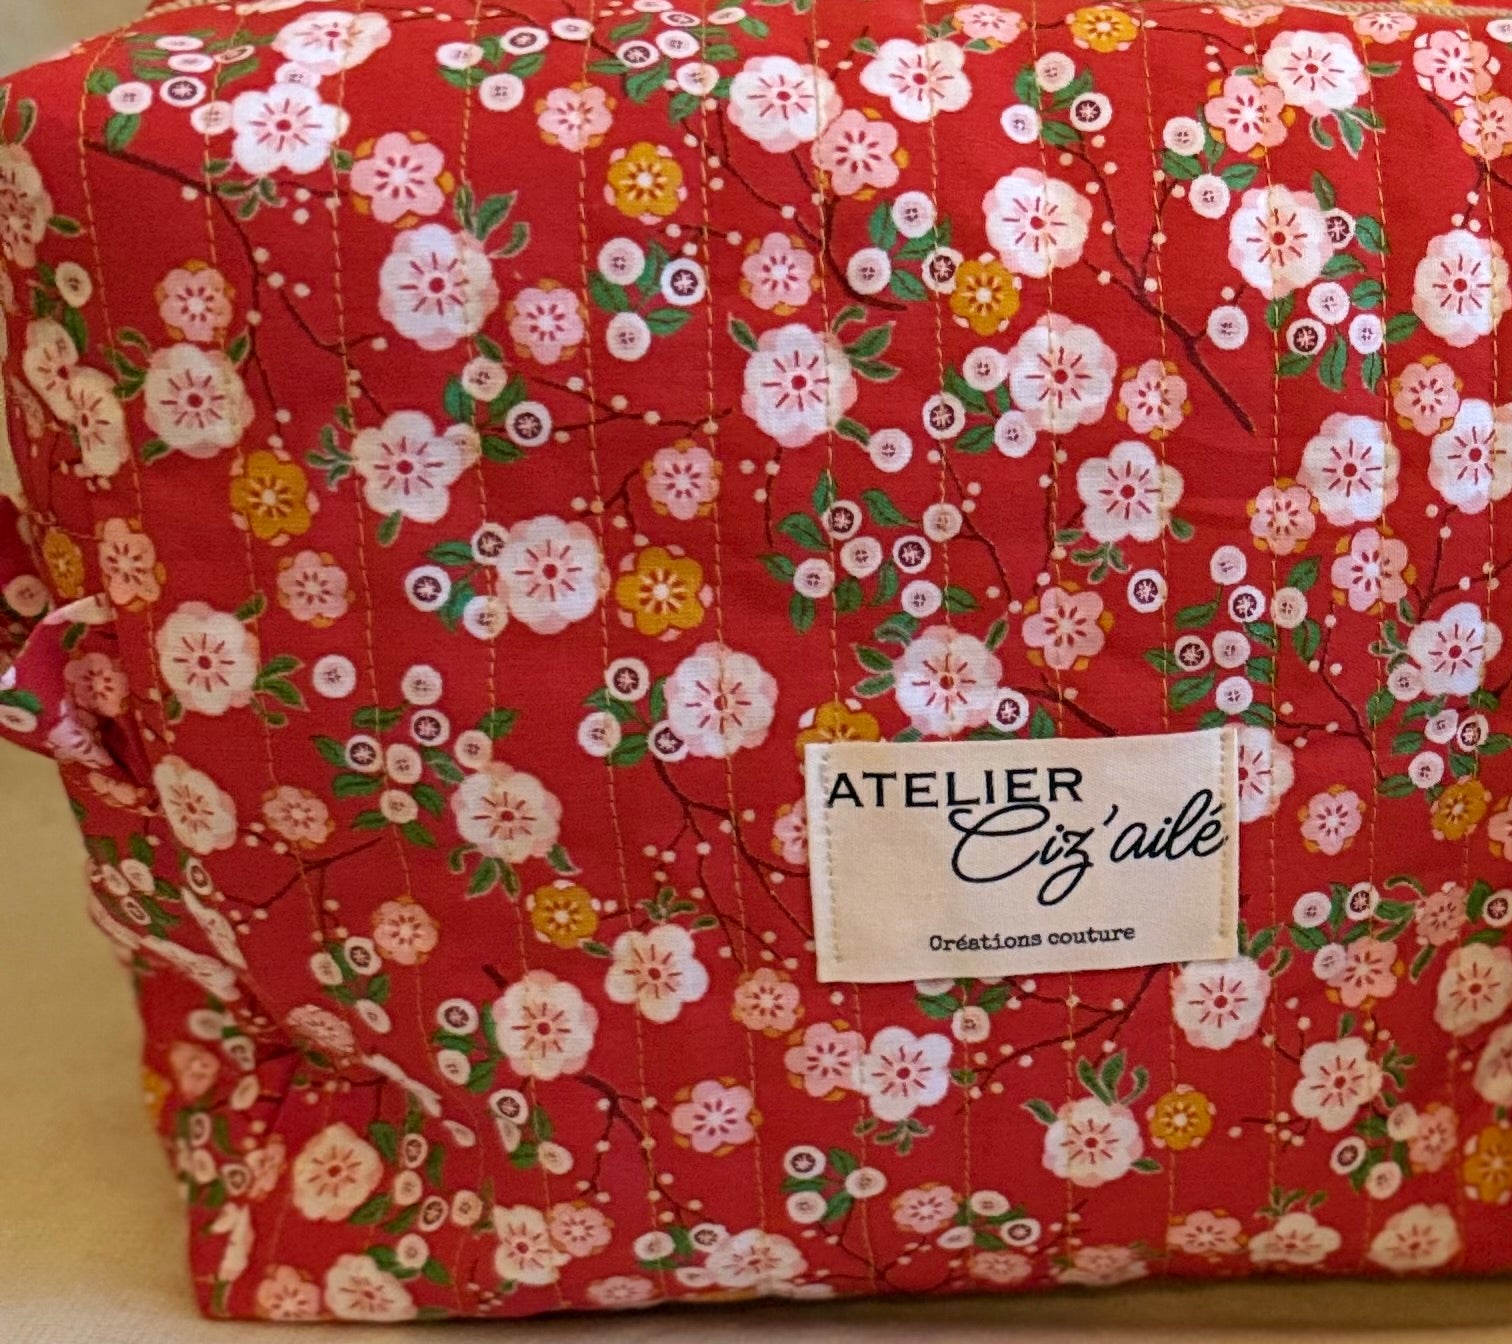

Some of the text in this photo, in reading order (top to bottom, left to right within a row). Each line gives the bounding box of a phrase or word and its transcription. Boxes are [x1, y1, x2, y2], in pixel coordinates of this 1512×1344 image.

[827, 767, 1083, 808] ATELIER
[928, 925, 1136, 952] Créations couture
